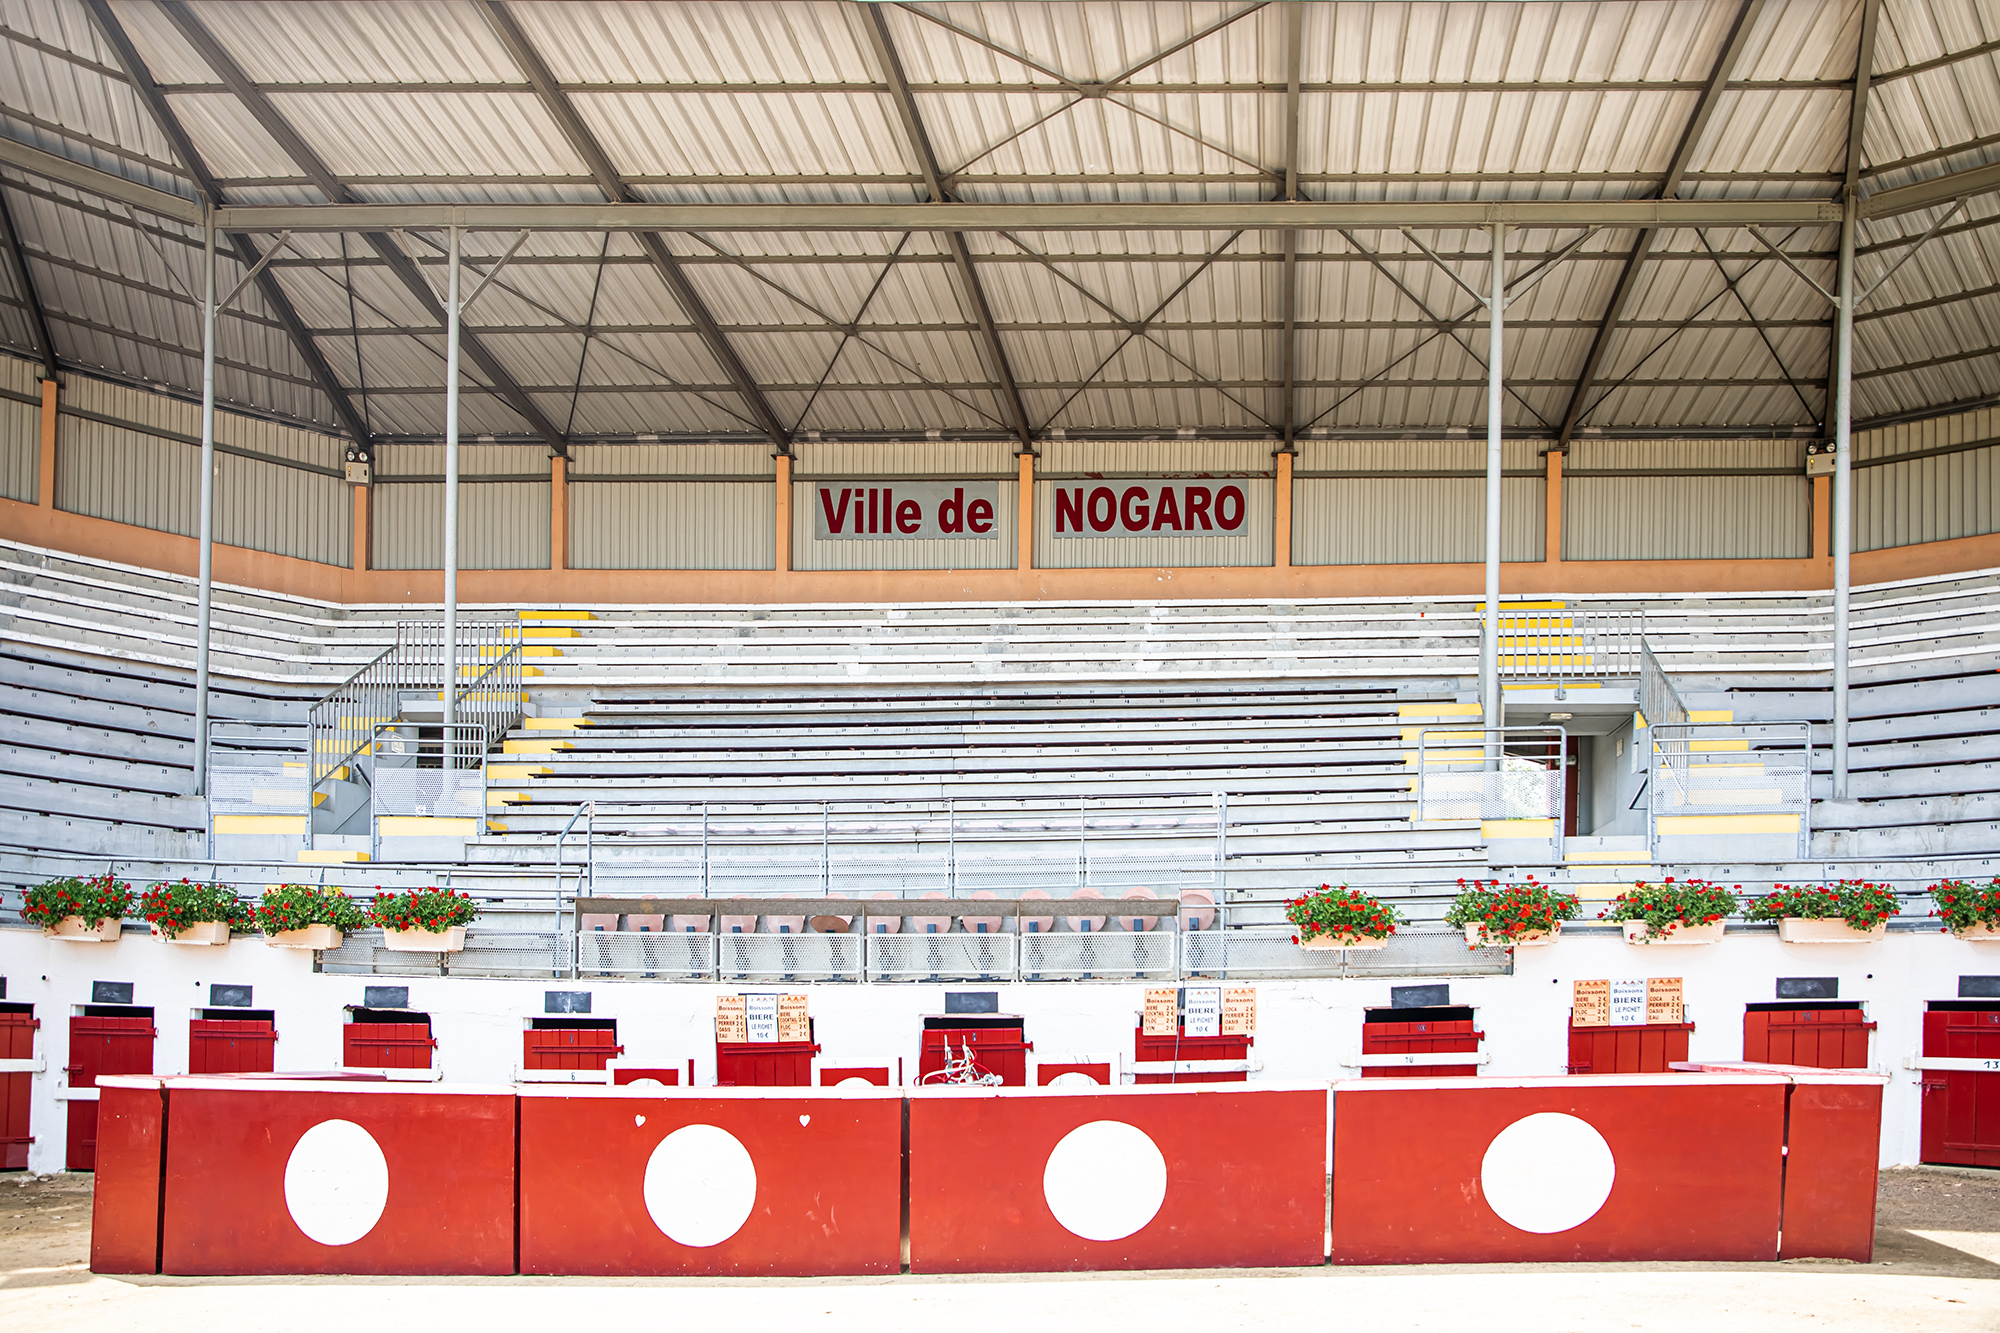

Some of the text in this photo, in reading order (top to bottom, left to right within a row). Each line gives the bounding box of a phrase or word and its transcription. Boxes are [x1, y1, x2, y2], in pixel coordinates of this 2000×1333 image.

[820, 488, 994, 534] Ville de
[1055, 485, 1246, 533] NOGARO
[571, 1072, 575, 1081] 6
[1984, 1061, 1999, 1069] 13
